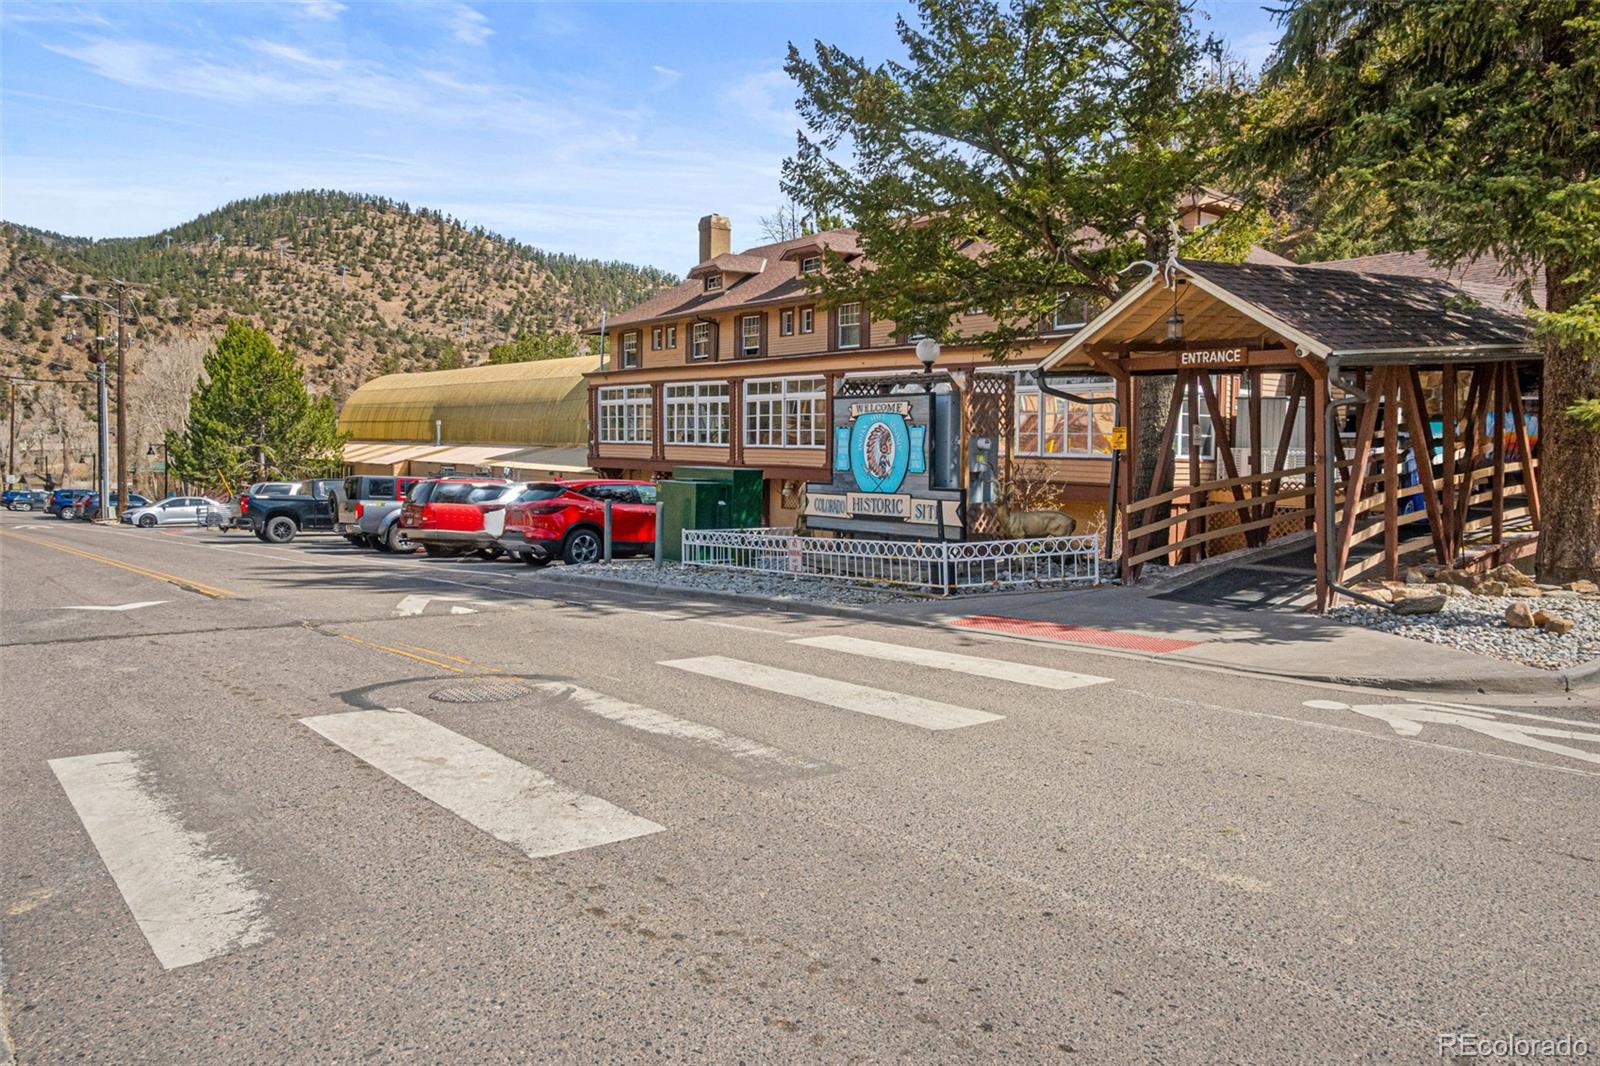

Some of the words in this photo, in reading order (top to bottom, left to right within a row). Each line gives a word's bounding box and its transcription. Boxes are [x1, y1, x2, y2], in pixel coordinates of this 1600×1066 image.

[1181, 349, 1241, 365] ENTRANCE
[856, 402, 904, 414] WELCOME
[814, 497, 846, 515] COLORADO
[852, 497, 904, 514] HISTORIC
